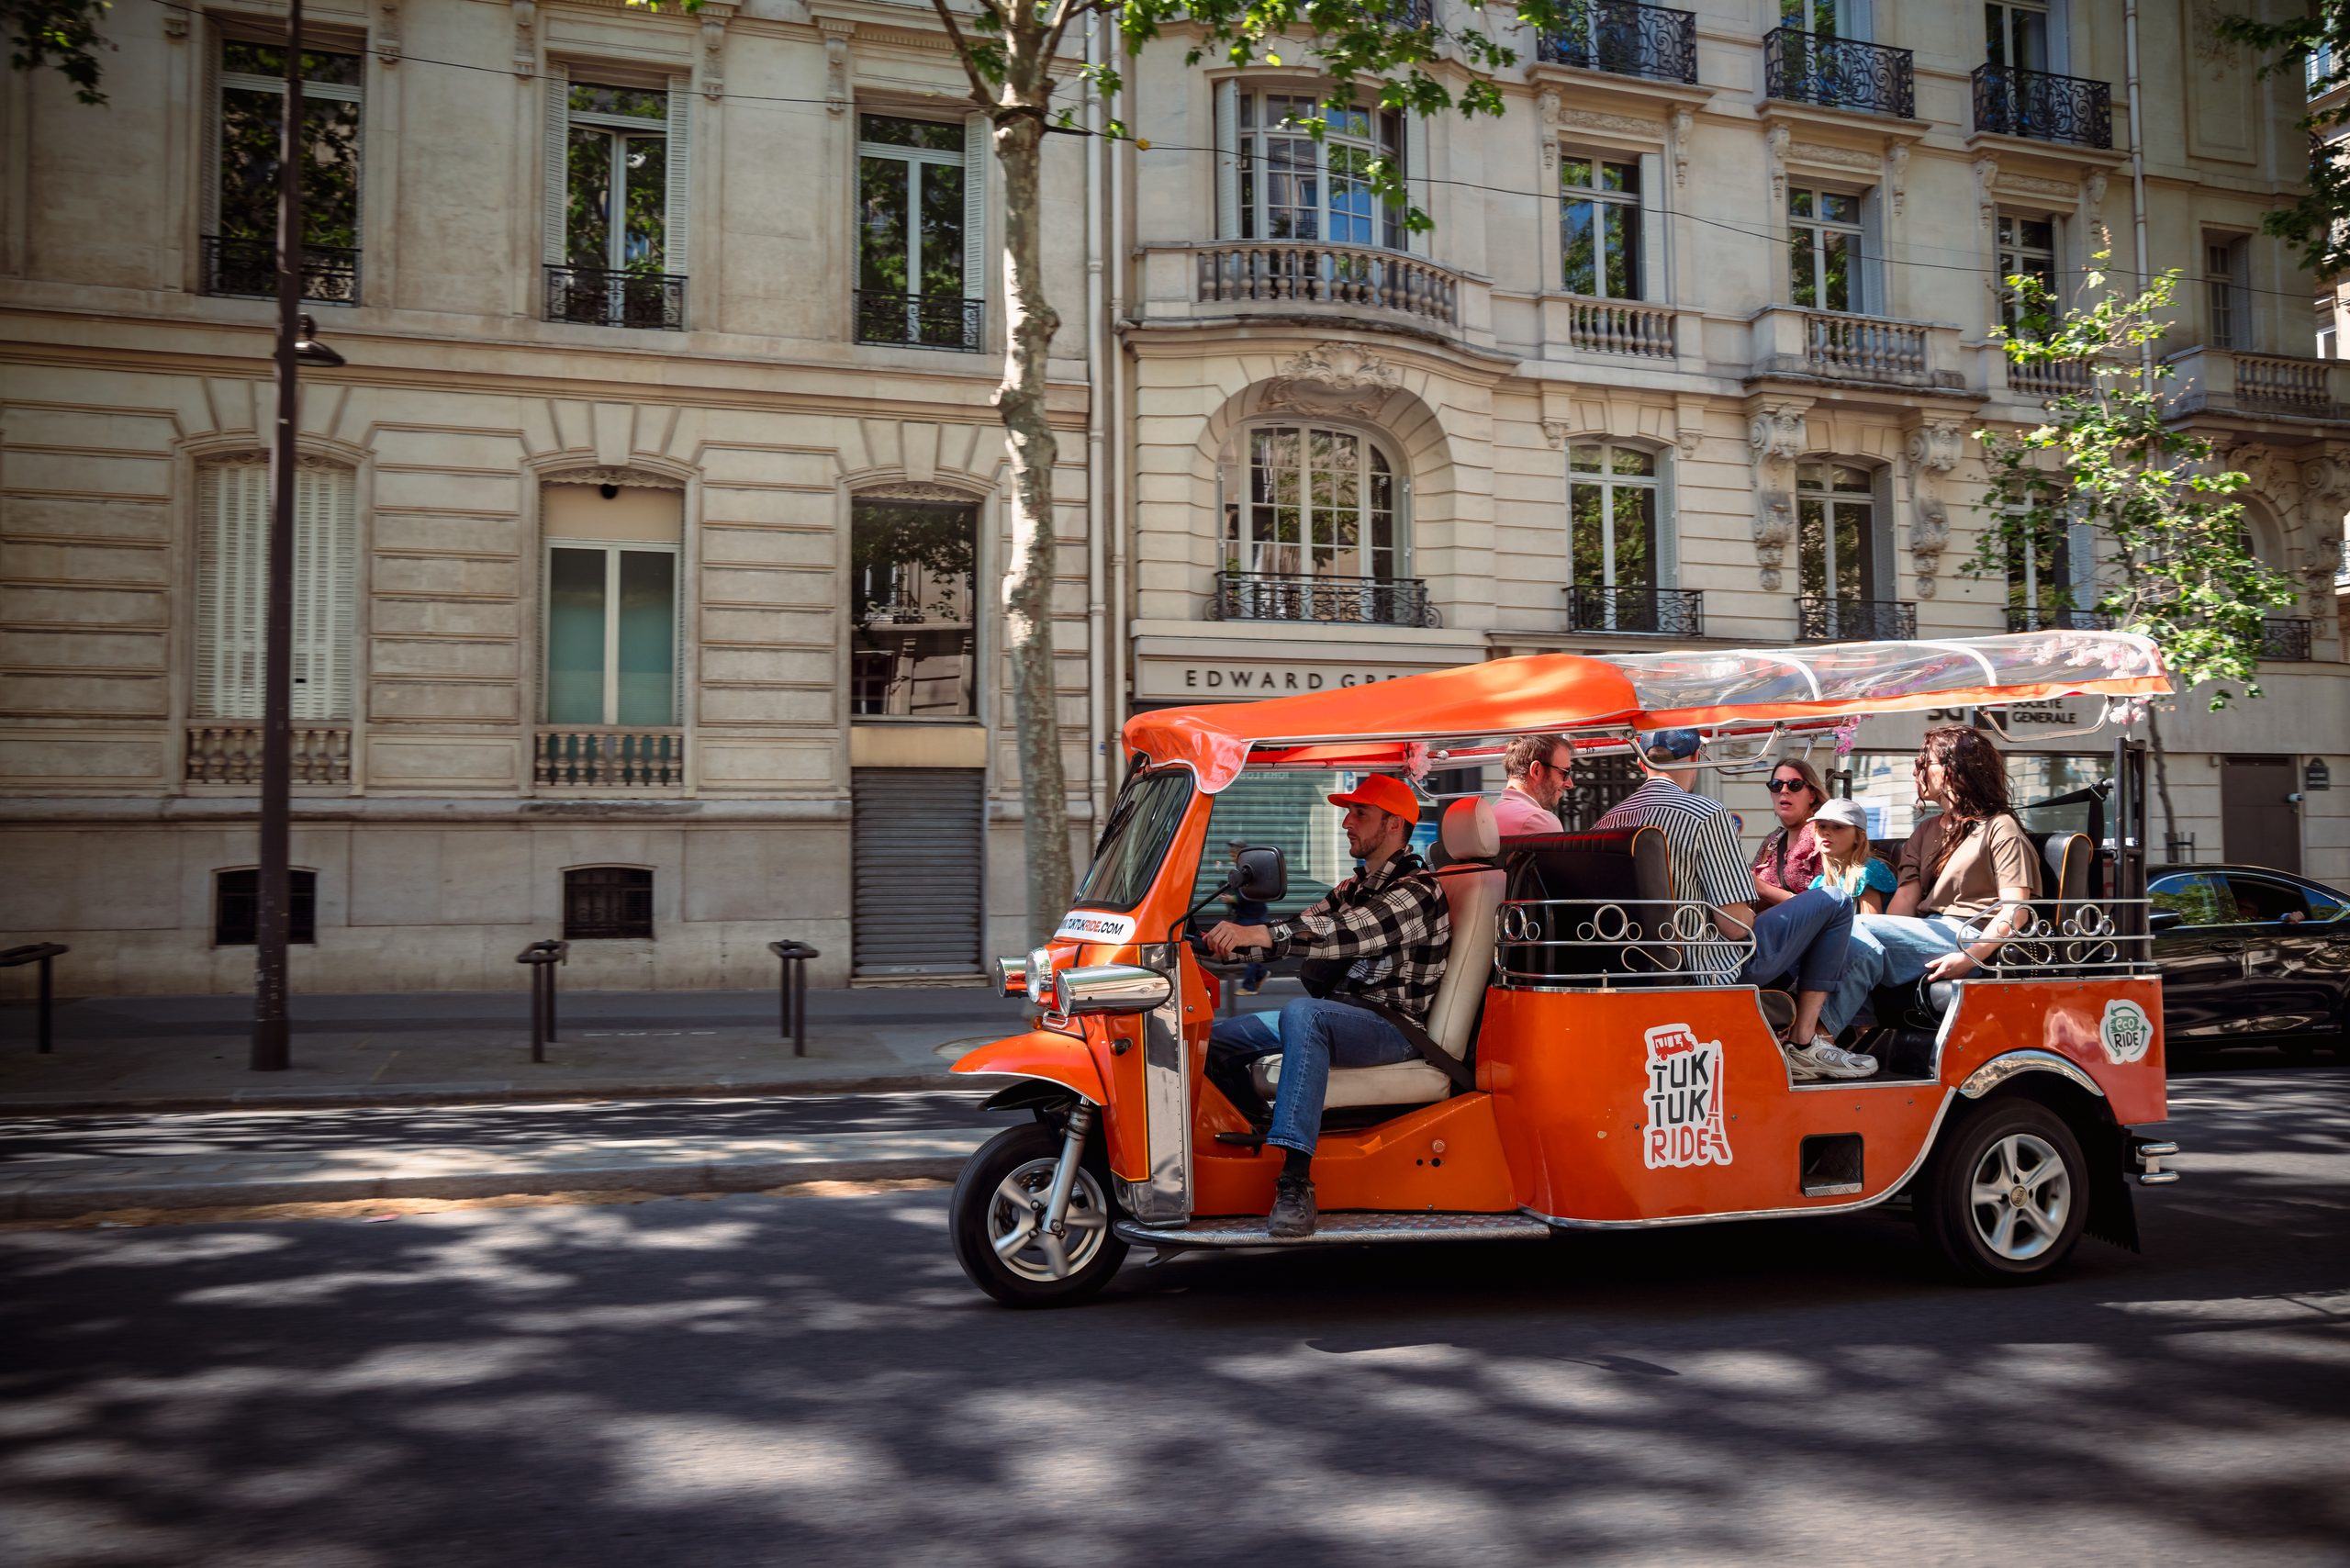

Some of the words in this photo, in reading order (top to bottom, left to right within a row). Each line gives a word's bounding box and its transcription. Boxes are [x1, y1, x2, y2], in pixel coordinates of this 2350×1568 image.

[1185, 669, 1323, 689] EDWARD
[2012, 711, 2076, 723] GENERALE
[2116, 1018, 2134, 1030] eco
[2113, 1032, 2139, 1047] RIDE
[1823, 1051, 1837, 1061] N
[1652, 1050, 1709, 1093] TUK
[1651, 1089, 1709, 1127] TUK
[1651, 1126, 1709, 1163] RIDE
